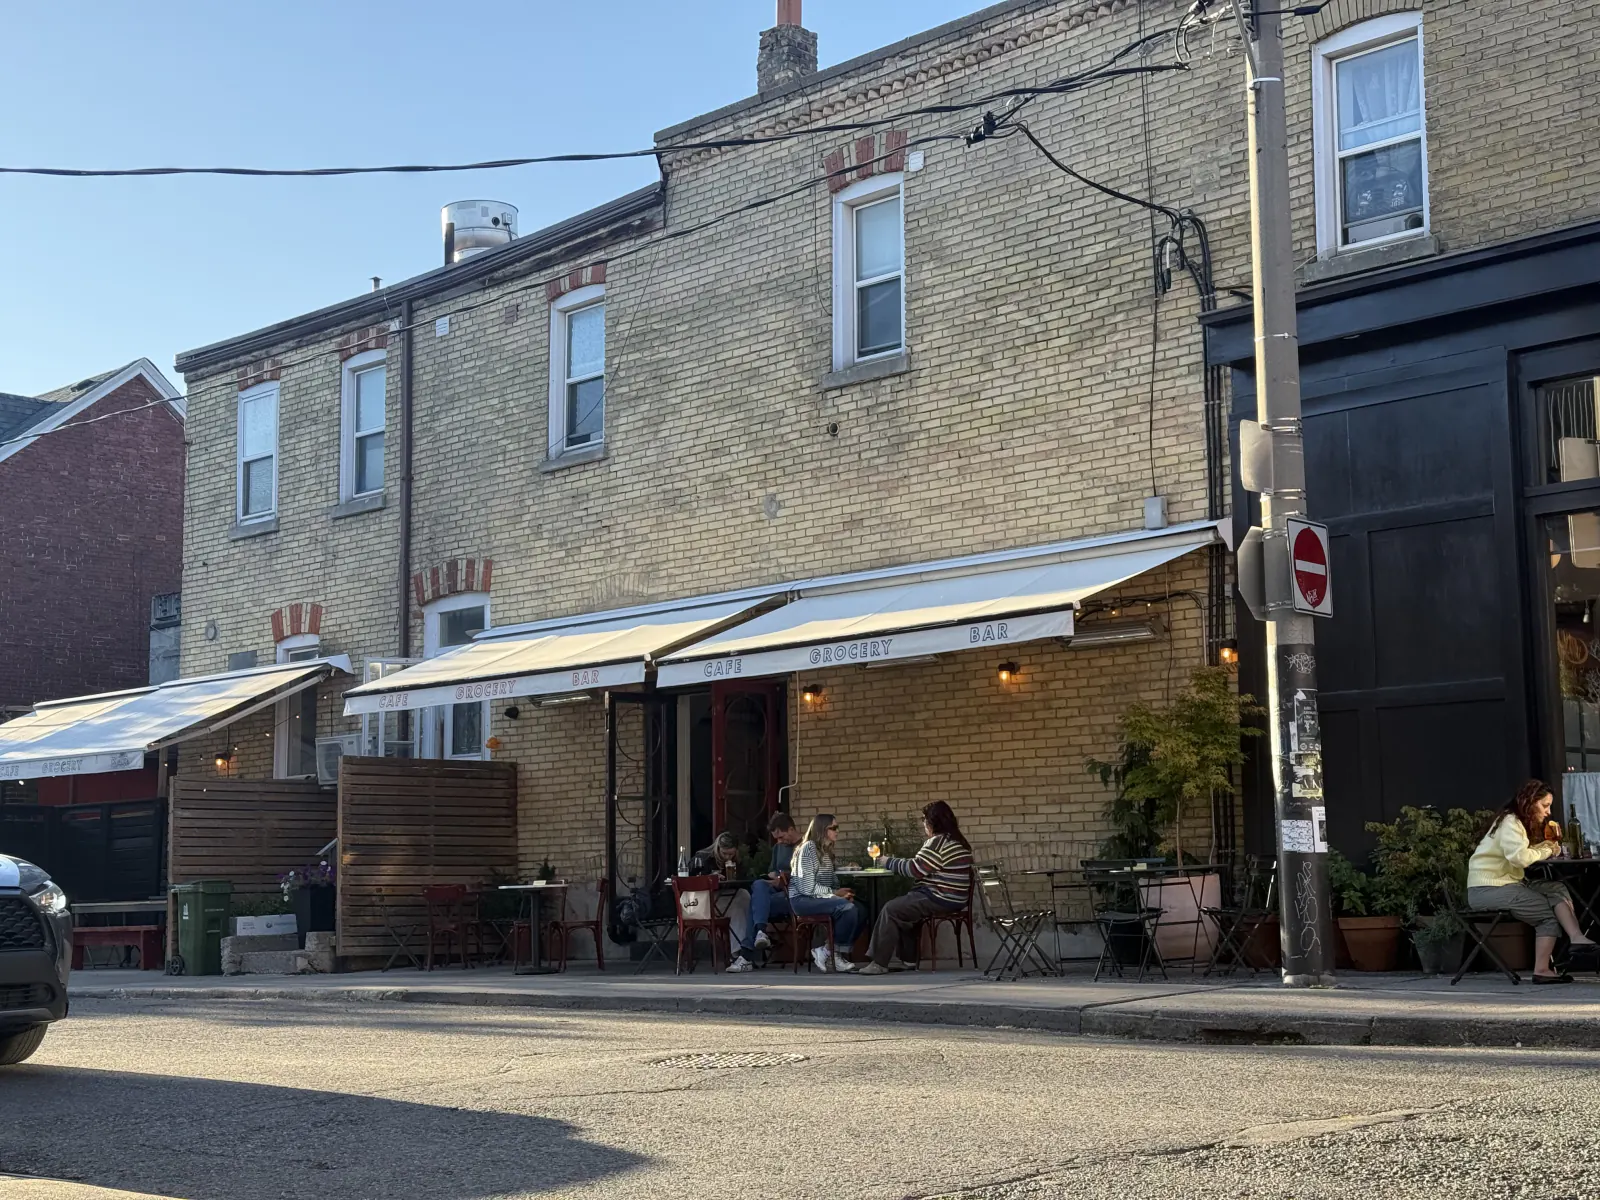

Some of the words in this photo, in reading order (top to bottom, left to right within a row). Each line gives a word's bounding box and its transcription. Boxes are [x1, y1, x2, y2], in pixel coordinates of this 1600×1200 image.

[704, 659, 742, 677] CAFE
[809, 639, 892, 665] GROCERY
[970, 623, 1008, 643] BAR
[379, 694, 408, 708] CAFE
[455, 680, 516, 700] GROCERY
[573, 670, 599, 686] BAR
[42, 759, 83, 774] GROCERY
